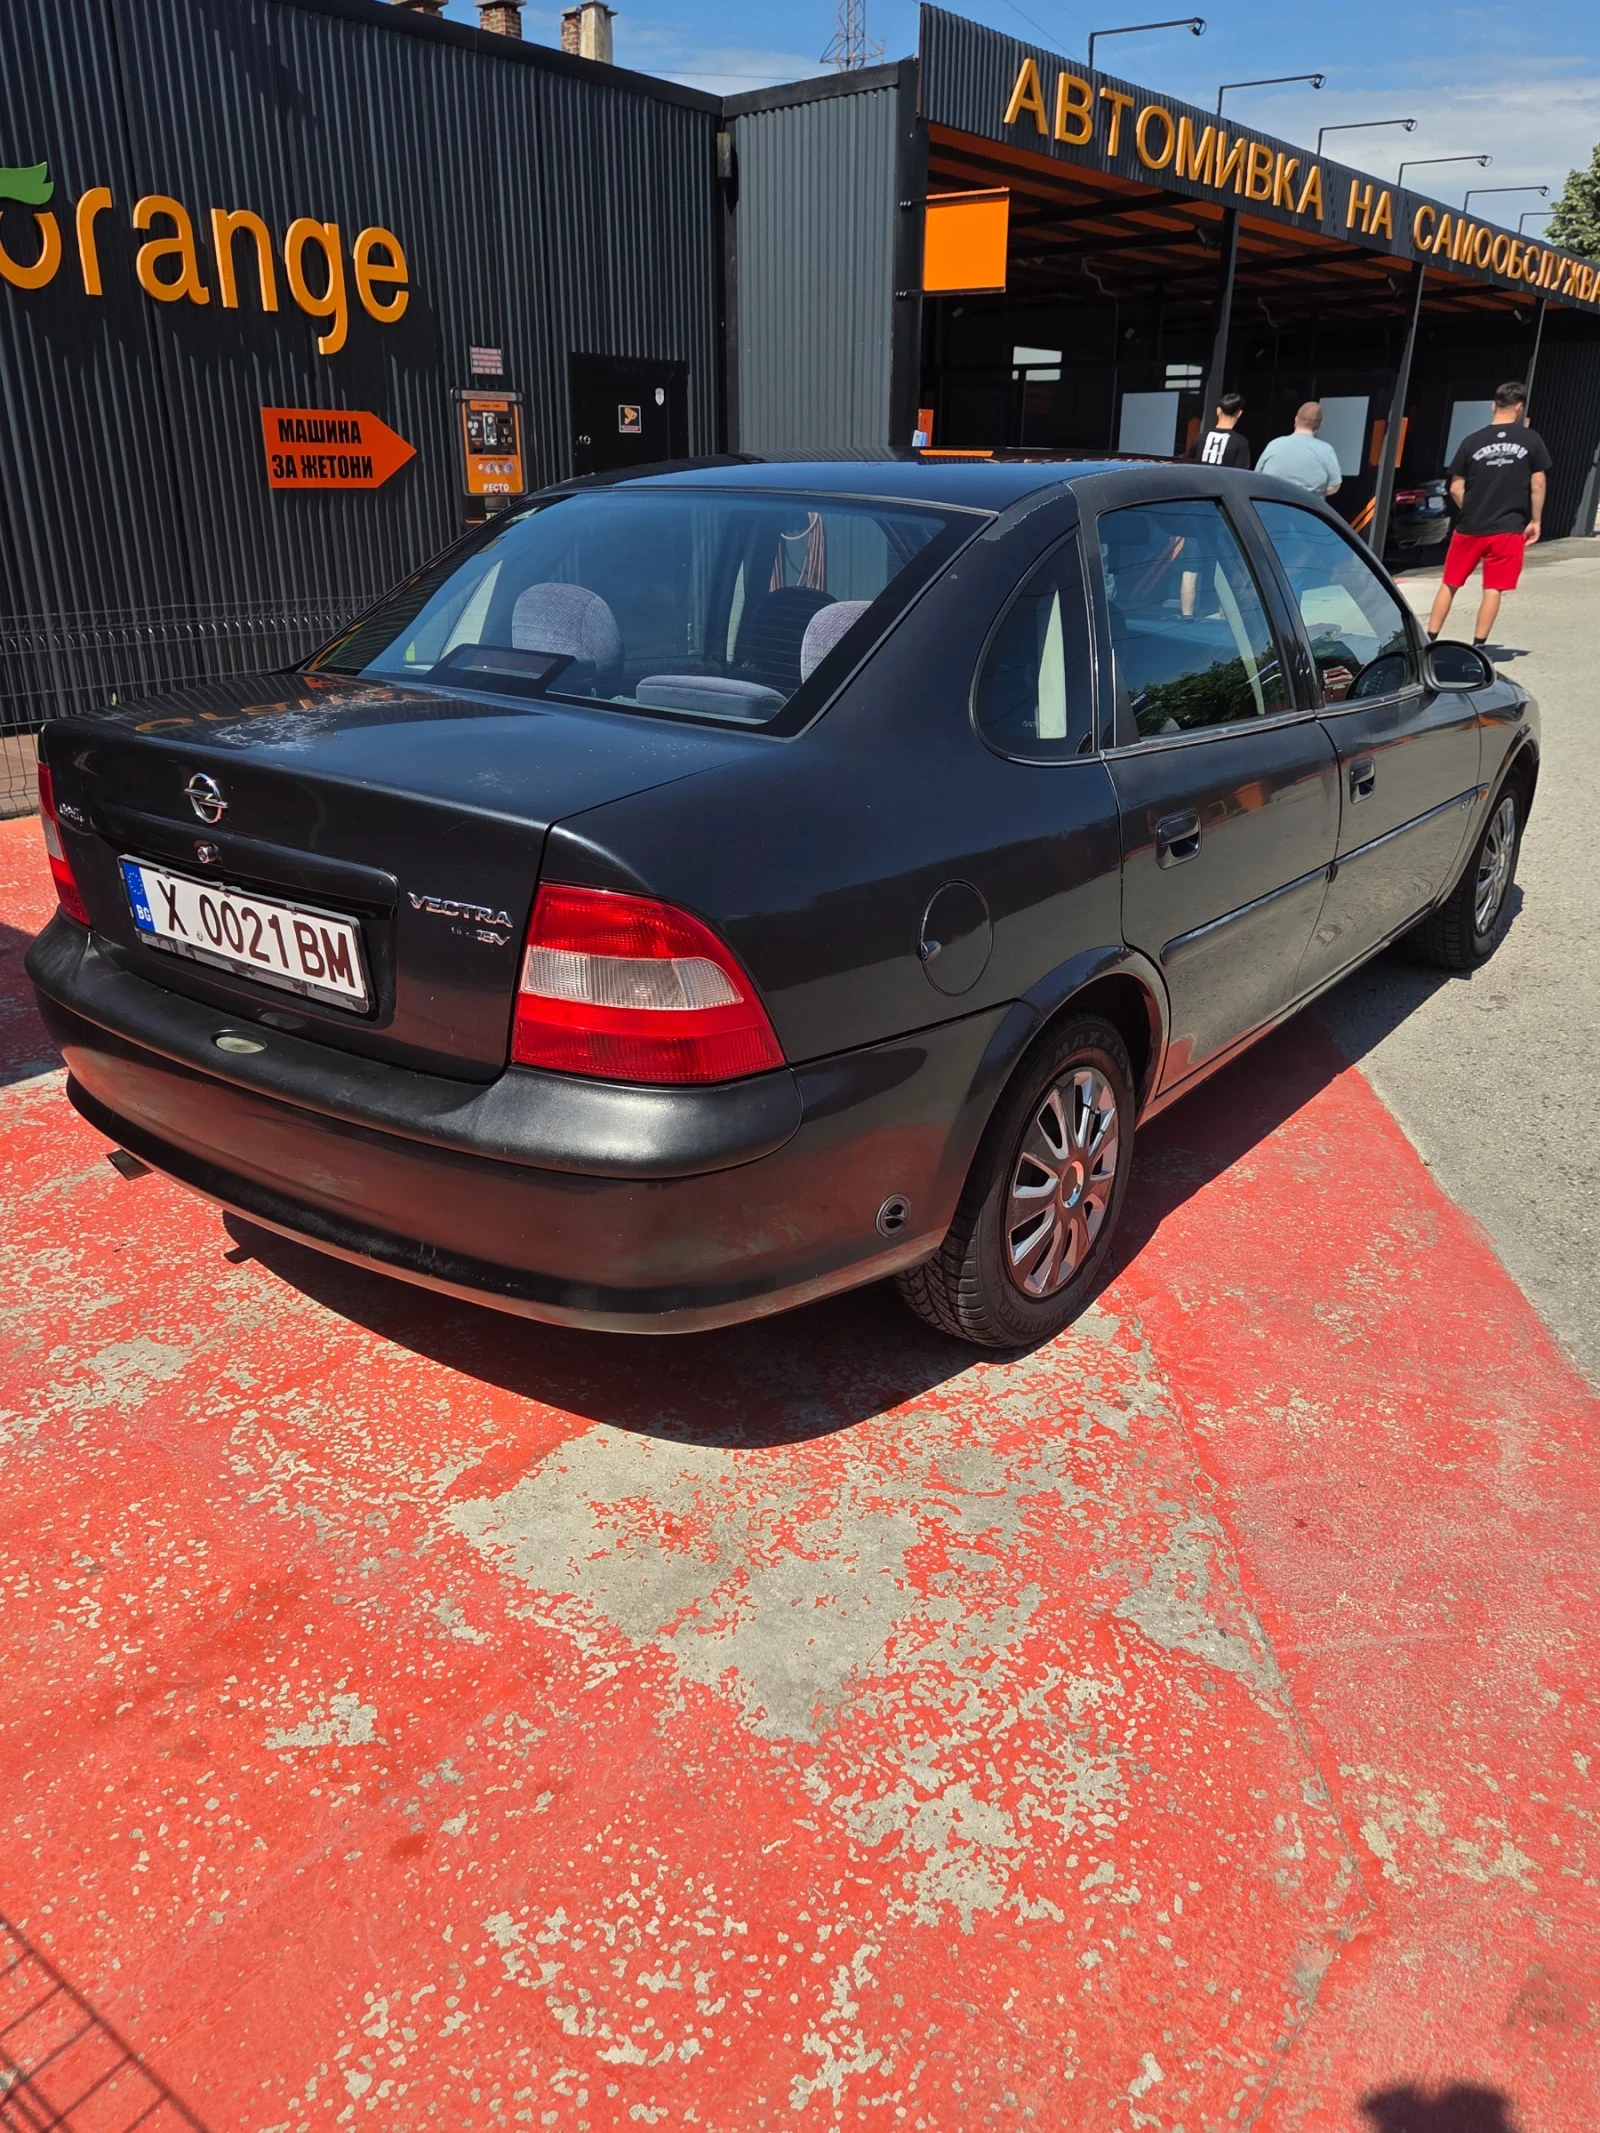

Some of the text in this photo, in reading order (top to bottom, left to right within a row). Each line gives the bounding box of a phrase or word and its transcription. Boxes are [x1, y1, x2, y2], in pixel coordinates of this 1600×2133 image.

[1003, 58, 1324, 221] АВТОМИВКА
[1346, 179, 1393, 240] НА
[0, 187, 409, 355] orange
[277, 418, 363, 444] МАШИНА
[271, 454, 374, 479] ЗА ЖЕТОНИ
[135, 903, 152, 923] BG
[407, 891, 514, 928] VECTRA
[199, 893, 290, 970] 0021
[293, 919, 357, 989] BM
